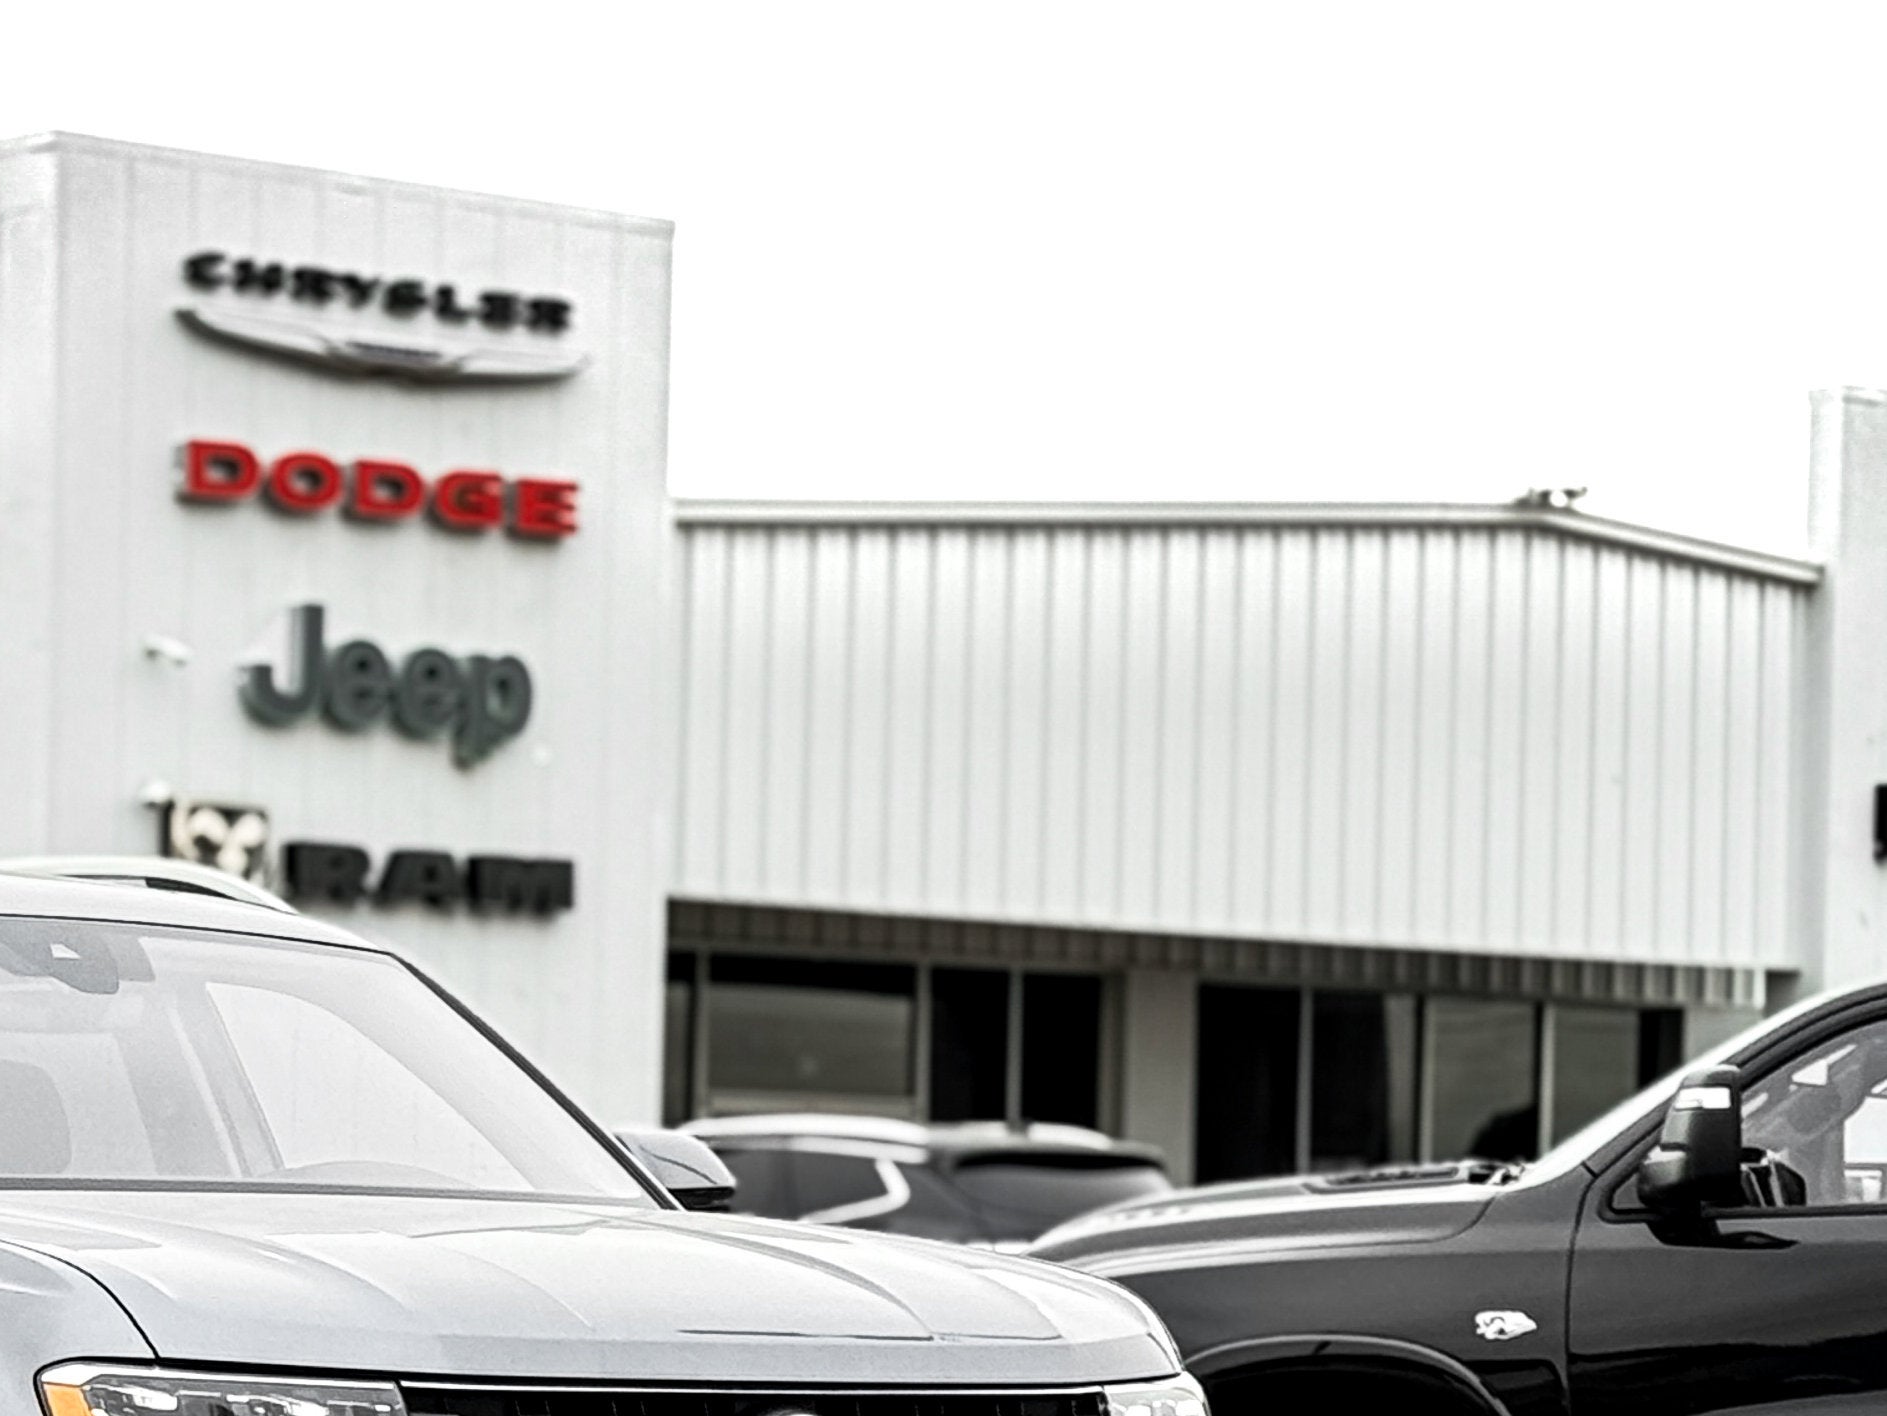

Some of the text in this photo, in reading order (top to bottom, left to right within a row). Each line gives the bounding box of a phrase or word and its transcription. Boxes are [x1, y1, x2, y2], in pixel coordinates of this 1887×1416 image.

[181, 249, 575, 335] CHRYSLER
[175, 438, 582, 543] DODGE
[237, 603, 534, 772] Jeep
[282, 842, 576, 916] RAM
